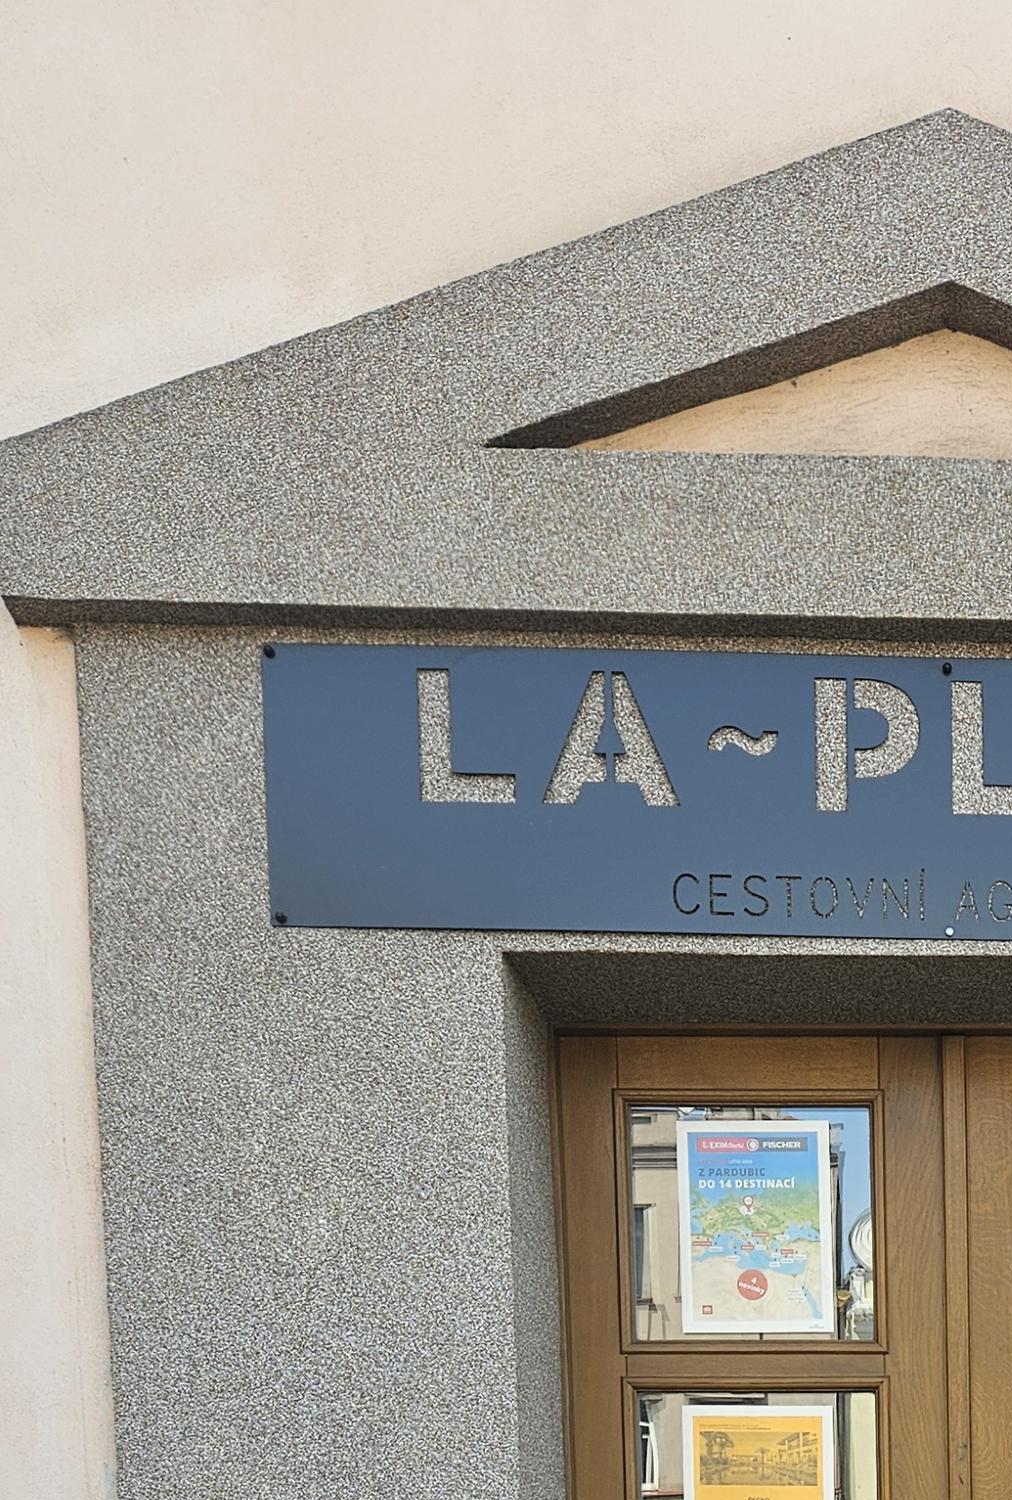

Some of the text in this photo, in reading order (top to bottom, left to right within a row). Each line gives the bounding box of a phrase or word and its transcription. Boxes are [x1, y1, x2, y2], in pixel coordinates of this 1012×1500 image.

[672, 868, 926, 922] CESTOVNÍ
[762, 1141, 801, 1149] FISCHER
[698, 1168, 766, 1177] Z PARDUBIC
[699, 1177, 795, 1189] DO 14 DESTINACÍ
